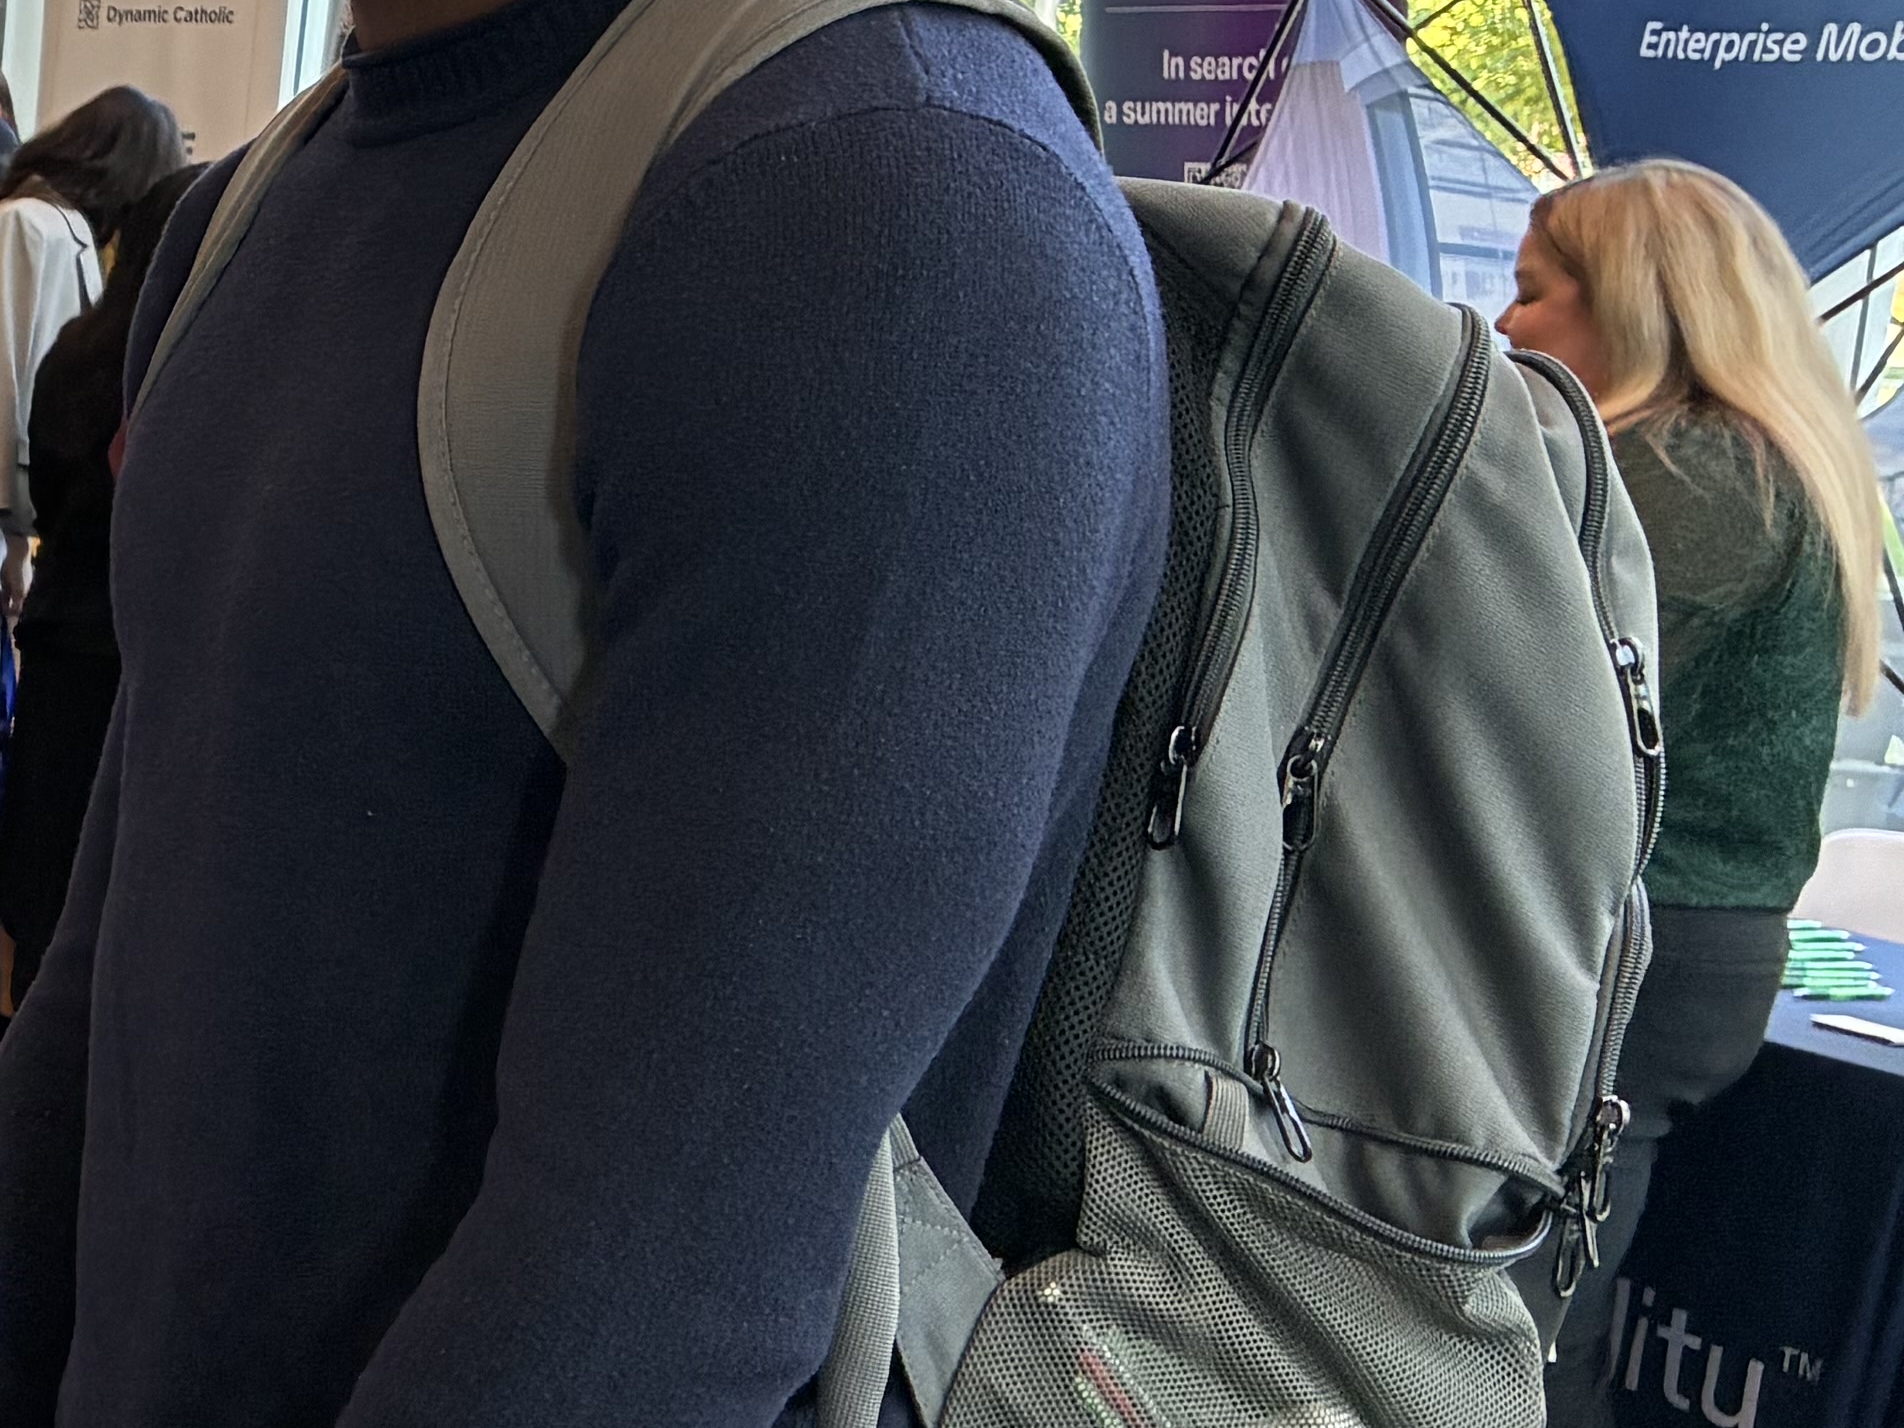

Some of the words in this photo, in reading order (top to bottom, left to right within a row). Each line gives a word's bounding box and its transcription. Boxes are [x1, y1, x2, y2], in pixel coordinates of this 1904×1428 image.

[106, 4, 168, 26] Dynamic
[173, 4, 235, 24] Catholic
[1639, 20, 1807, 71] Enterprise
[1163, 49, 1185, 81] In
[1104, 104, 1118, 125] a
[1121, 98, 1219, 128] summer
